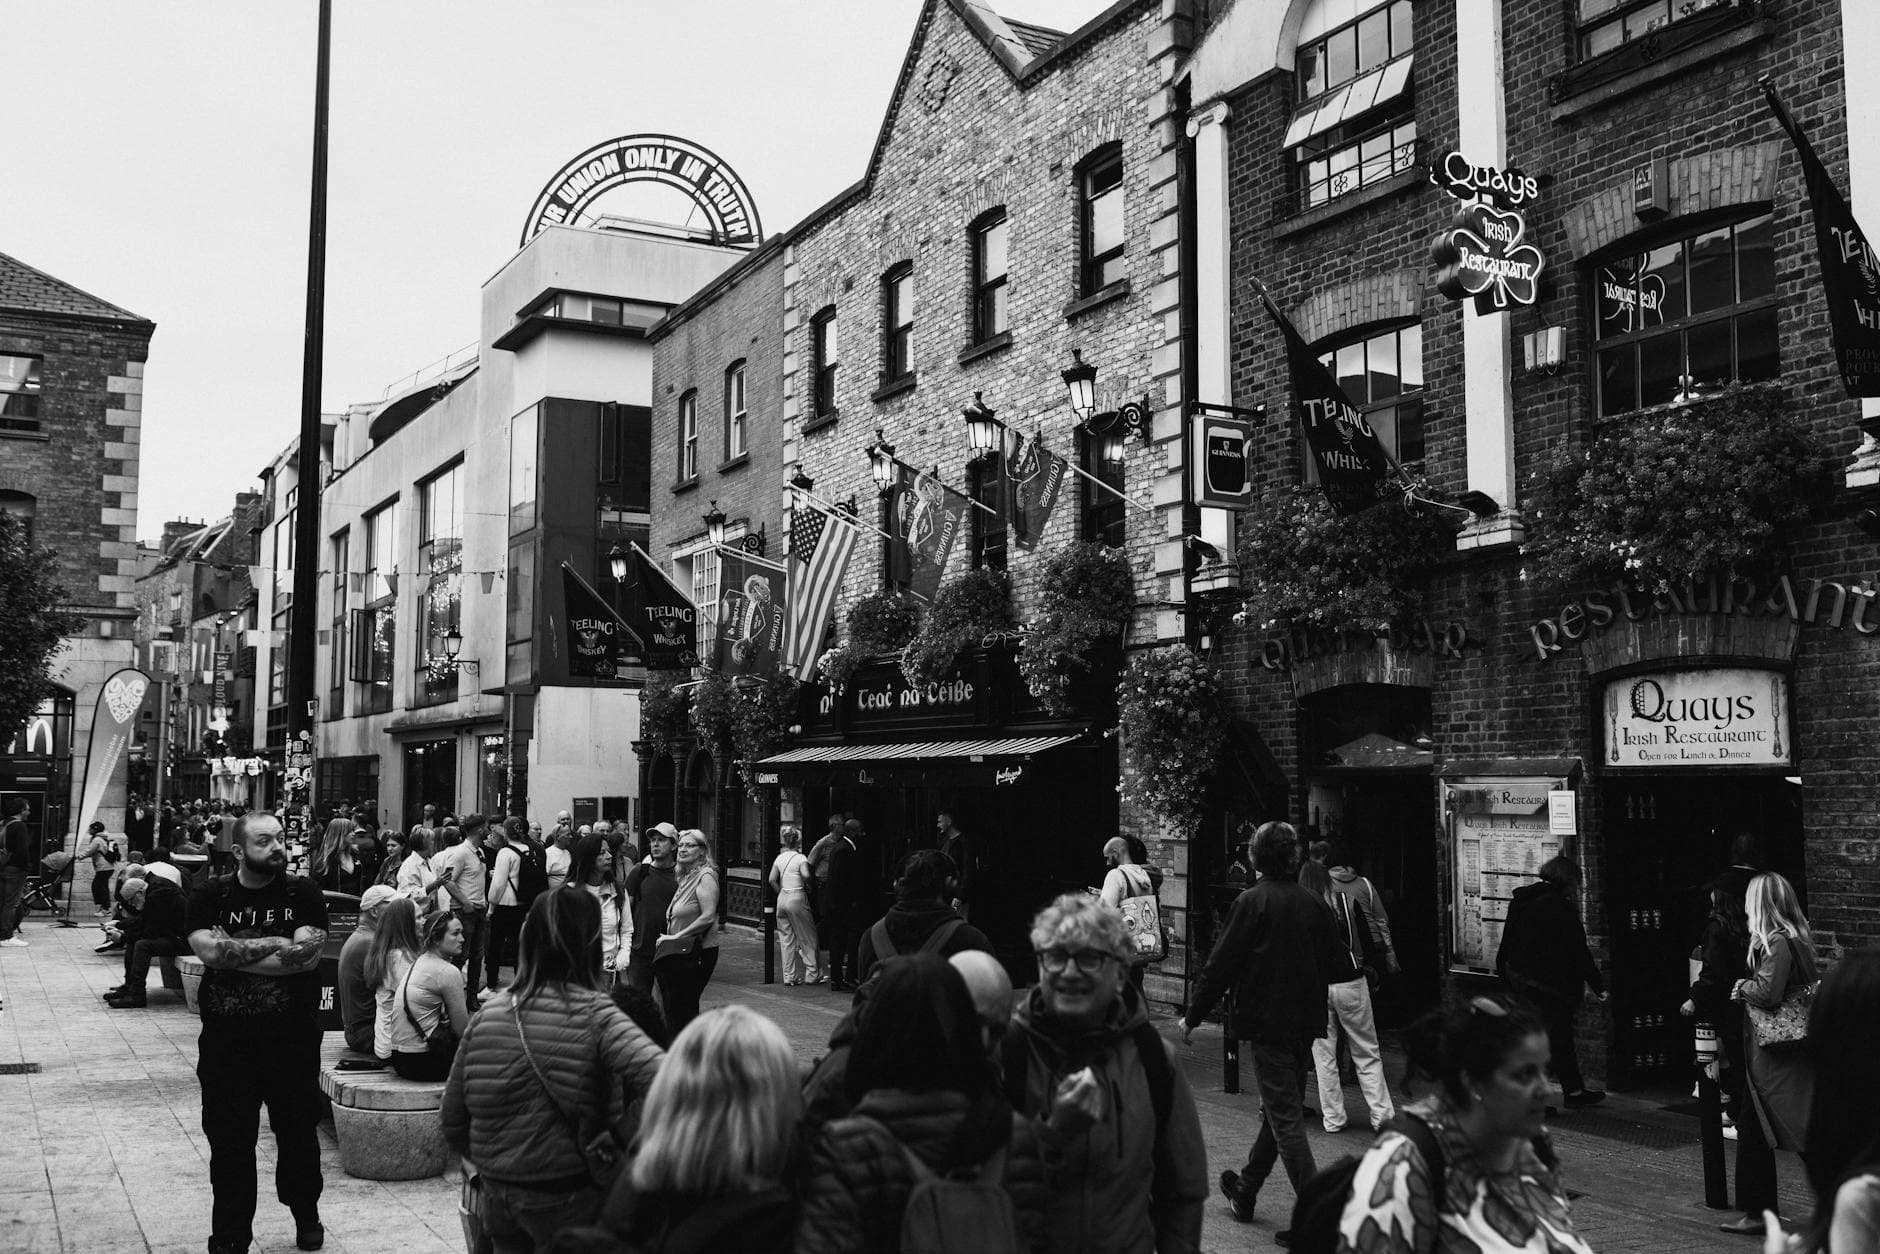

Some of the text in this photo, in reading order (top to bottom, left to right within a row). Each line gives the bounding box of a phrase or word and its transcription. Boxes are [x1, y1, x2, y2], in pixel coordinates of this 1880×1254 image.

[1444, 151, 1538, 204] Quays
[556, 153, 620, 205] UNION
[624, 147, 682, 171] ONLY
[680, 155, 708, 183] IN
[703, 172, 750, 236] TRUTH
[1459, 246, 1532, 280] Restaurant
[1211, 449, 1241, 459] GUINNESS
[645, 606, 692, 623] TEELING
[570, 618, 613, 635] TEELING
[1630, 679, 1755, 730] Quays
[1622, 725, 1767, 746] Irish Restaurant
[1638, 749, 1661, 760] Open
[1681, 748, 1707, 760] Lunch
[1719, 748, 1751, 759] Dinner
